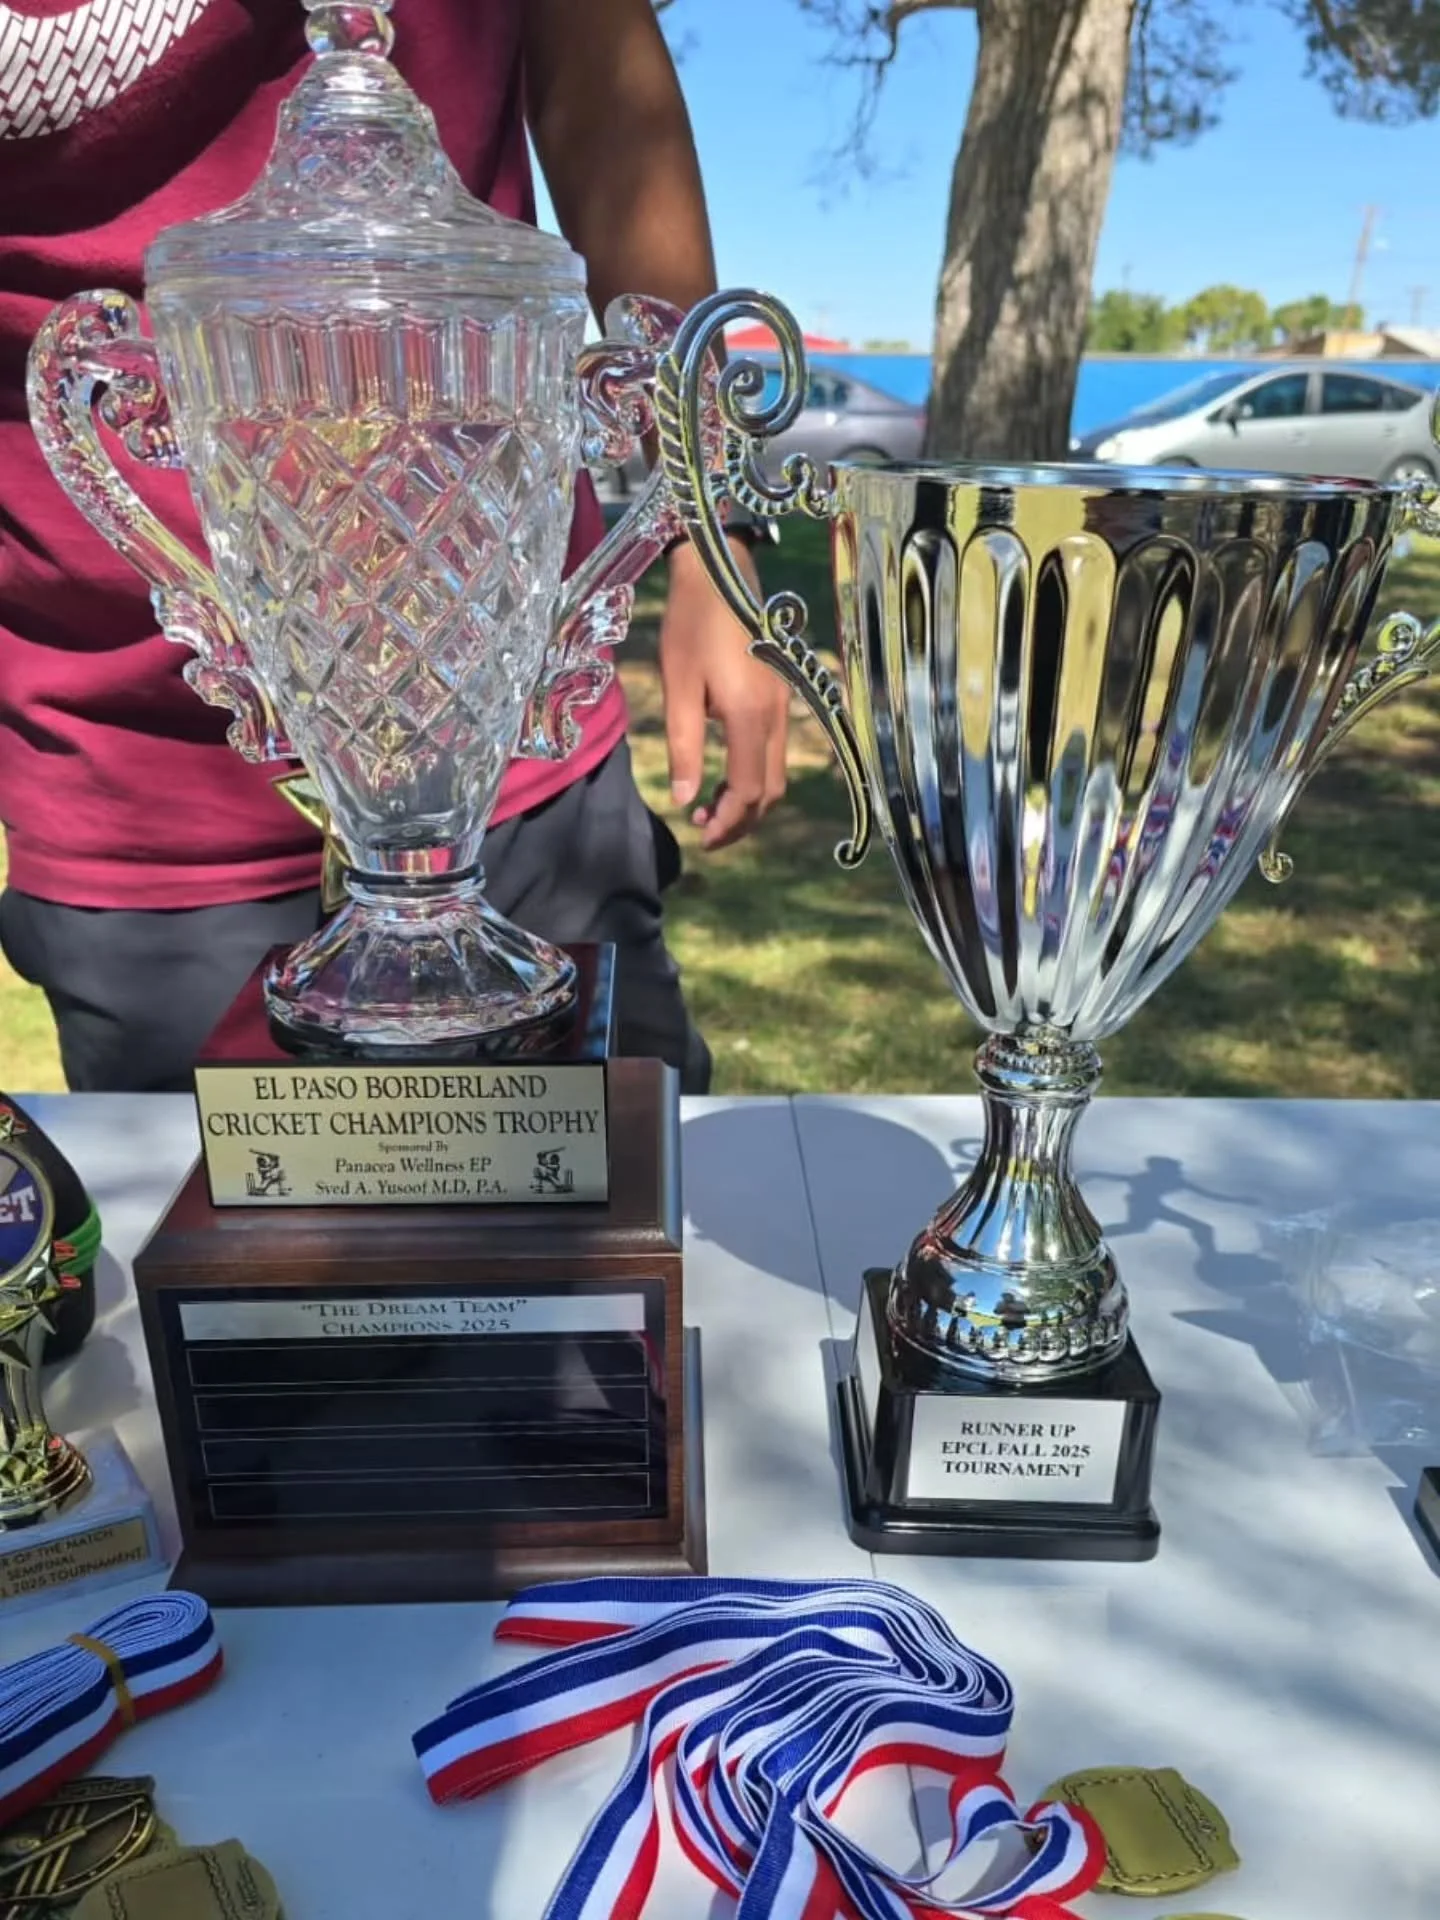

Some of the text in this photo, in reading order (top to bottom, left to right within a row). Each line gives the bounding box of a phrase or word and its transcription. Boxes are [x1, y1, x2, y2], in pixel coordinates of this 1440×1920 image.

[254, 1074, 547, 1100] EL PASO BORDERLAND
[207, 1110, 599, 1136] CRICKET CHAMPIONS TROPHY
[378, 1141, 433, 1154] Sponsored
[335, 1156, 492, 1174] Panacea Wellness EP
[354, 1181, 372, 1195] A.
[459, 1318, 511, 1333] 2025
[960, 1421, 1076, 1438] RUNNER UP
[941, 1441, 1091, 1459] EPCL FALL 2025
[942, 1460, 1085, 1478] TOURNAMENT
[65, 1528, 113, 1549] MATCH
